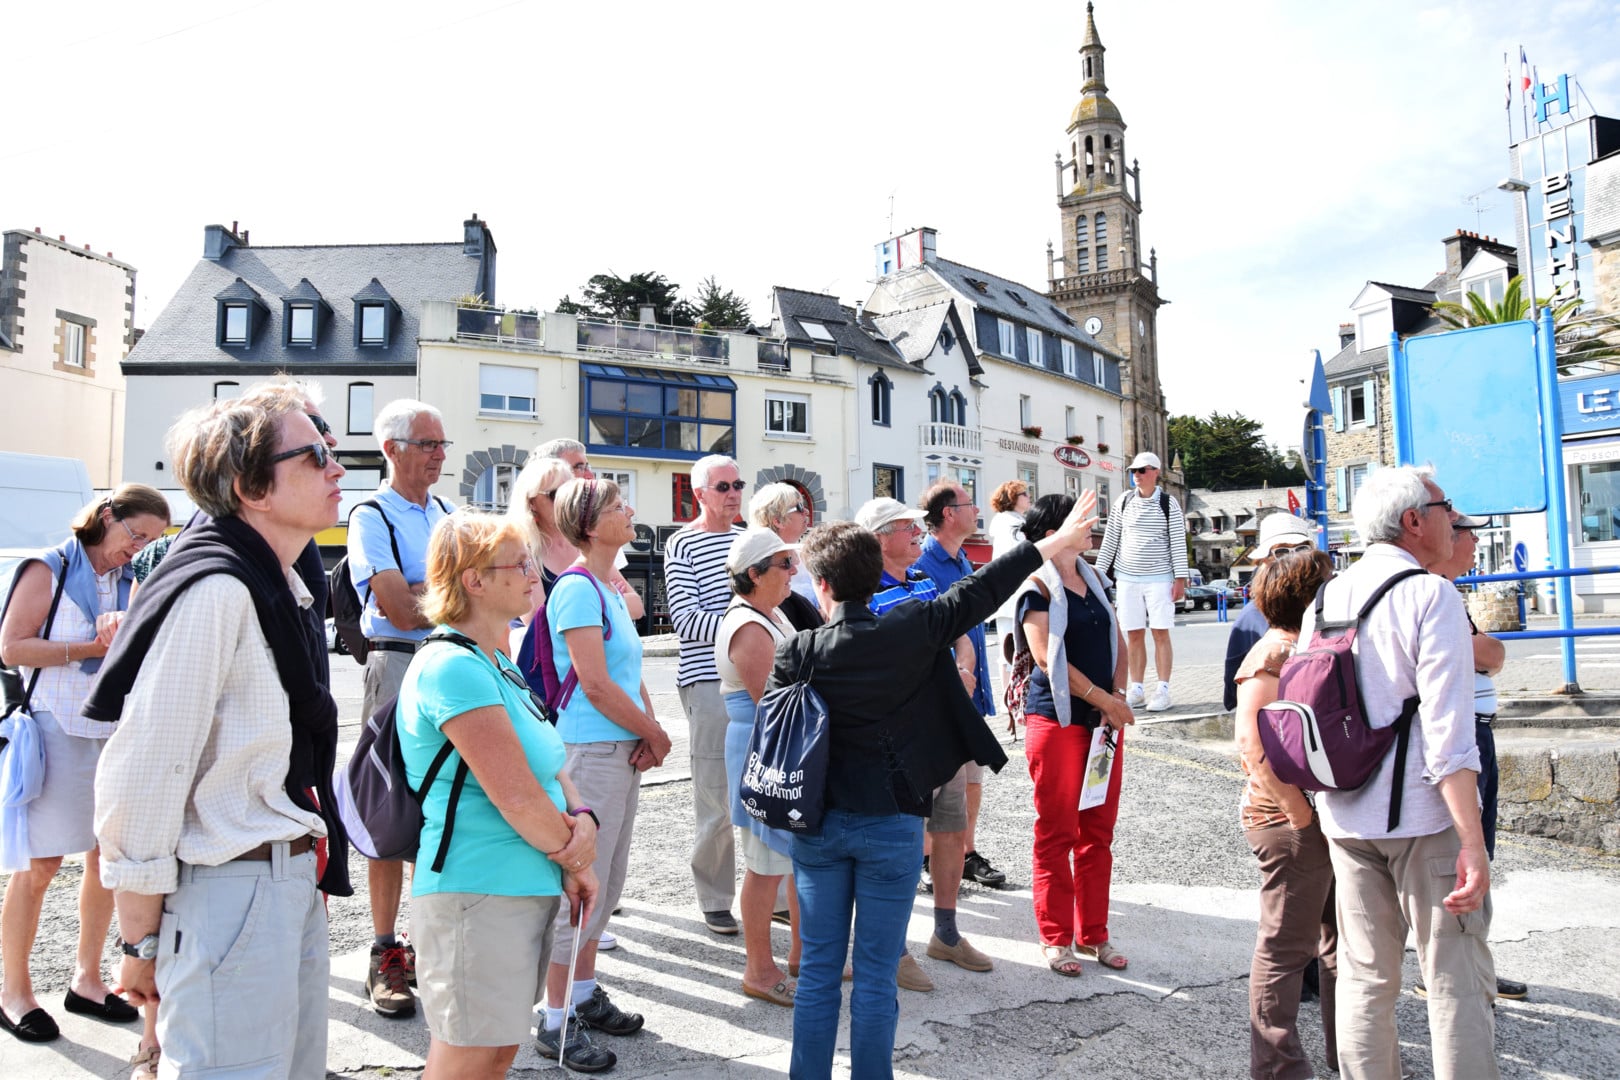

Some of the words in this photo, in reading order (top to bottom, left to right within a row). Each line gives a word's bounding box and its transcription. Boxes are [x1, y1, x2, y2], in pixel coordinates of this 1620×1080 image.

[1535, 73, 1569, 123] H
[1576, 388, 1612, 414] LE
[999, 438, 1040, 455] RESTAURANT
[789, 769, 804, 784] en
[765, 781, 804, 800] d'Armor
